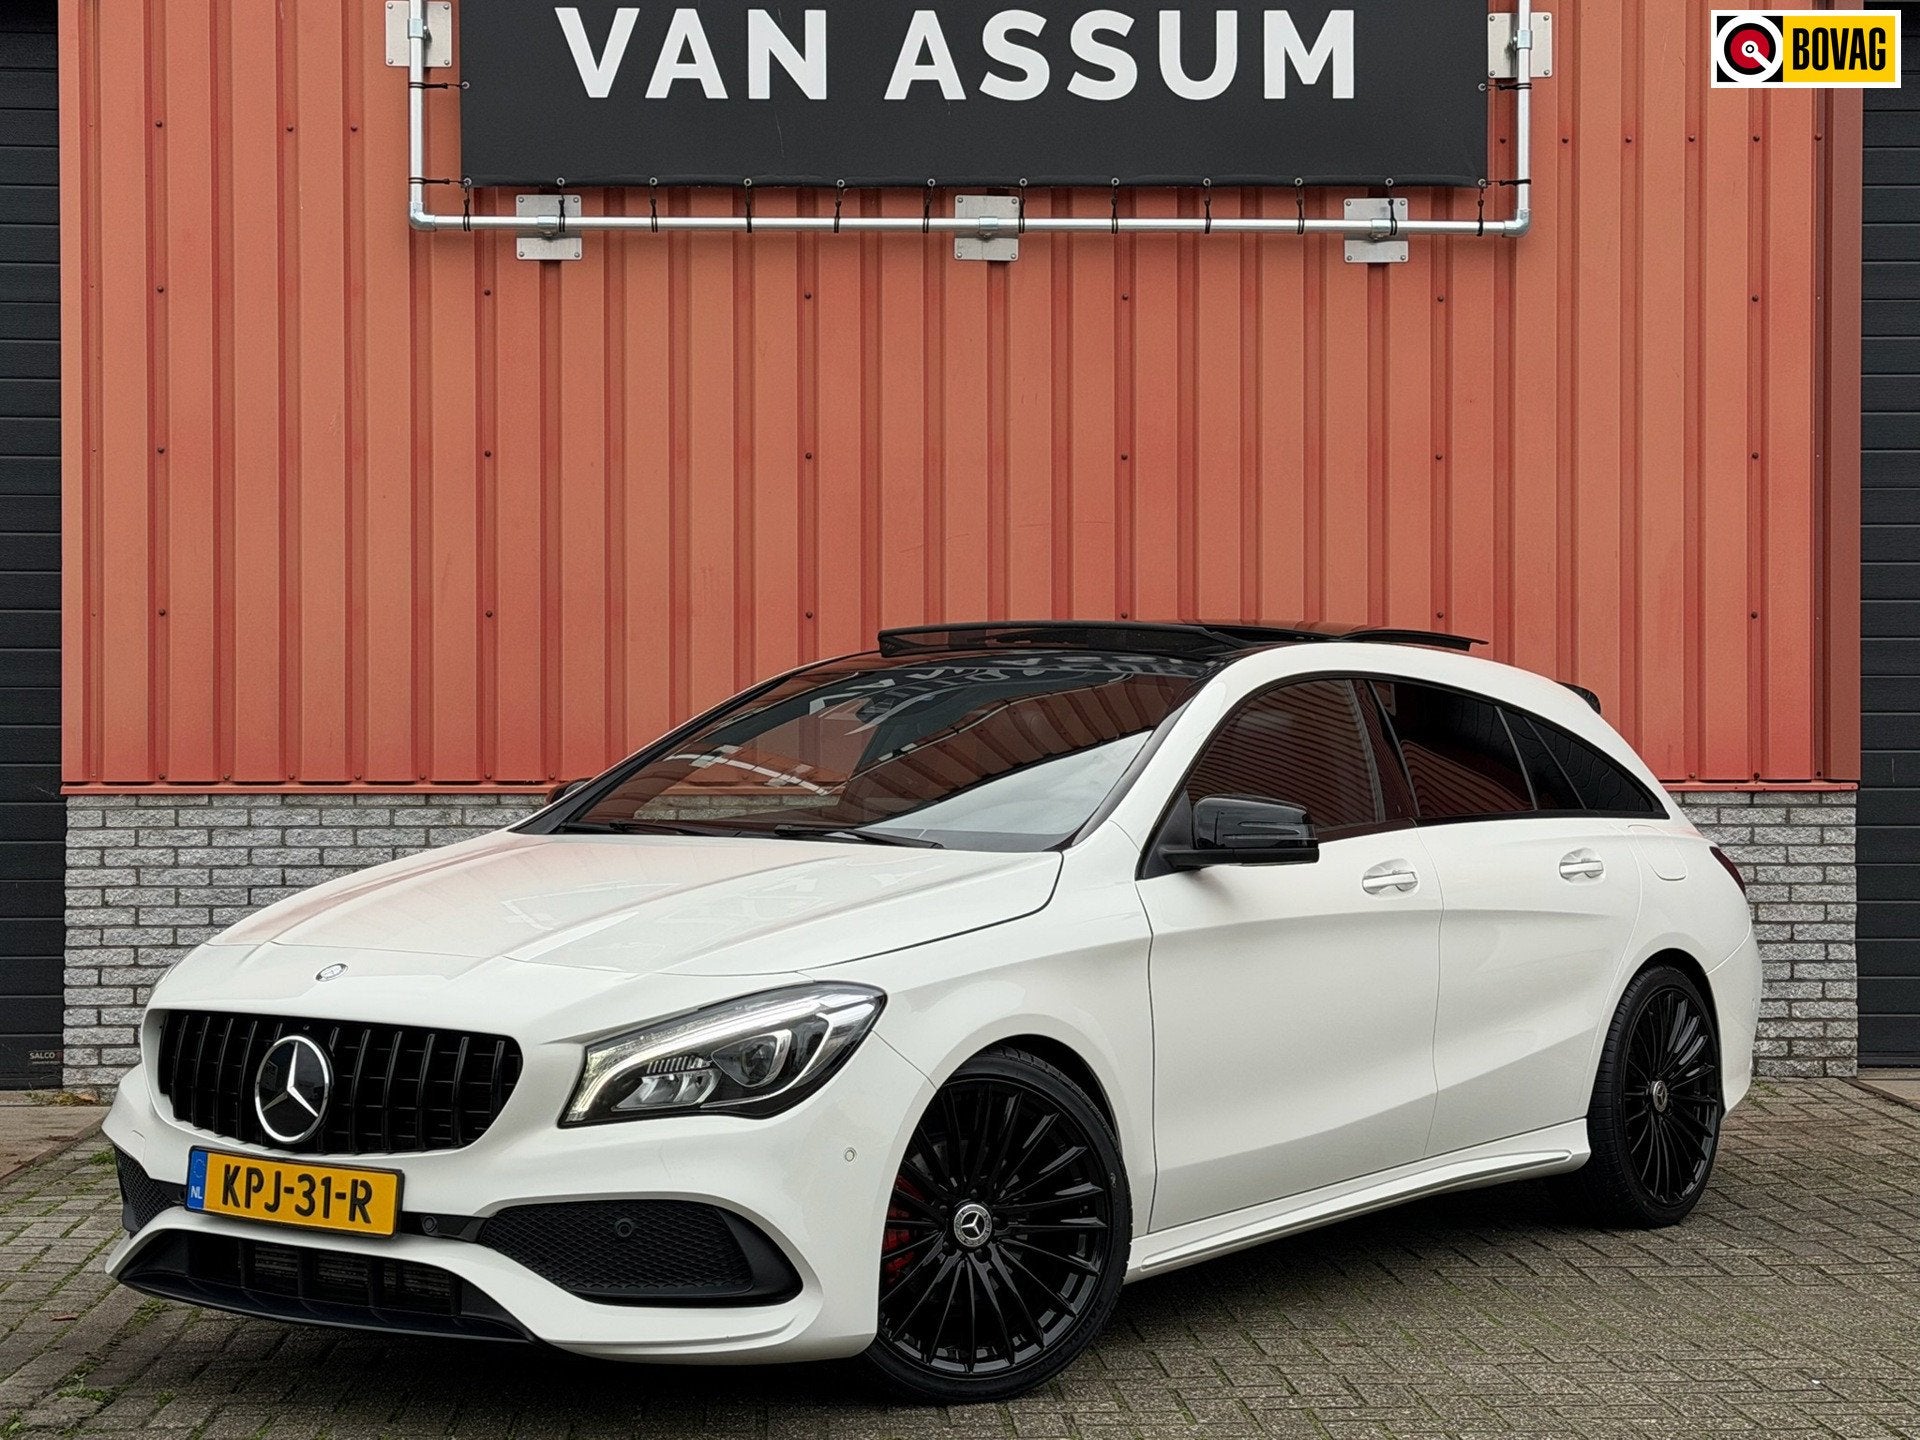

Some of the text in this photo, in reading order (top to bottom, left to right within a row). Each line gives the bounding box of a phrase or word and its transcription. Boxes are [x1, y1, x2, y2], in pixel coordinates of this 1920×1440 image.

[555, 7, 1356, 101] VAN ASSUM
[29, 1051, 55, 1059] SALCO
[190, 1186, 203, 1200] NL
[221, 1163, 373, 1225] KPJ-31-R
